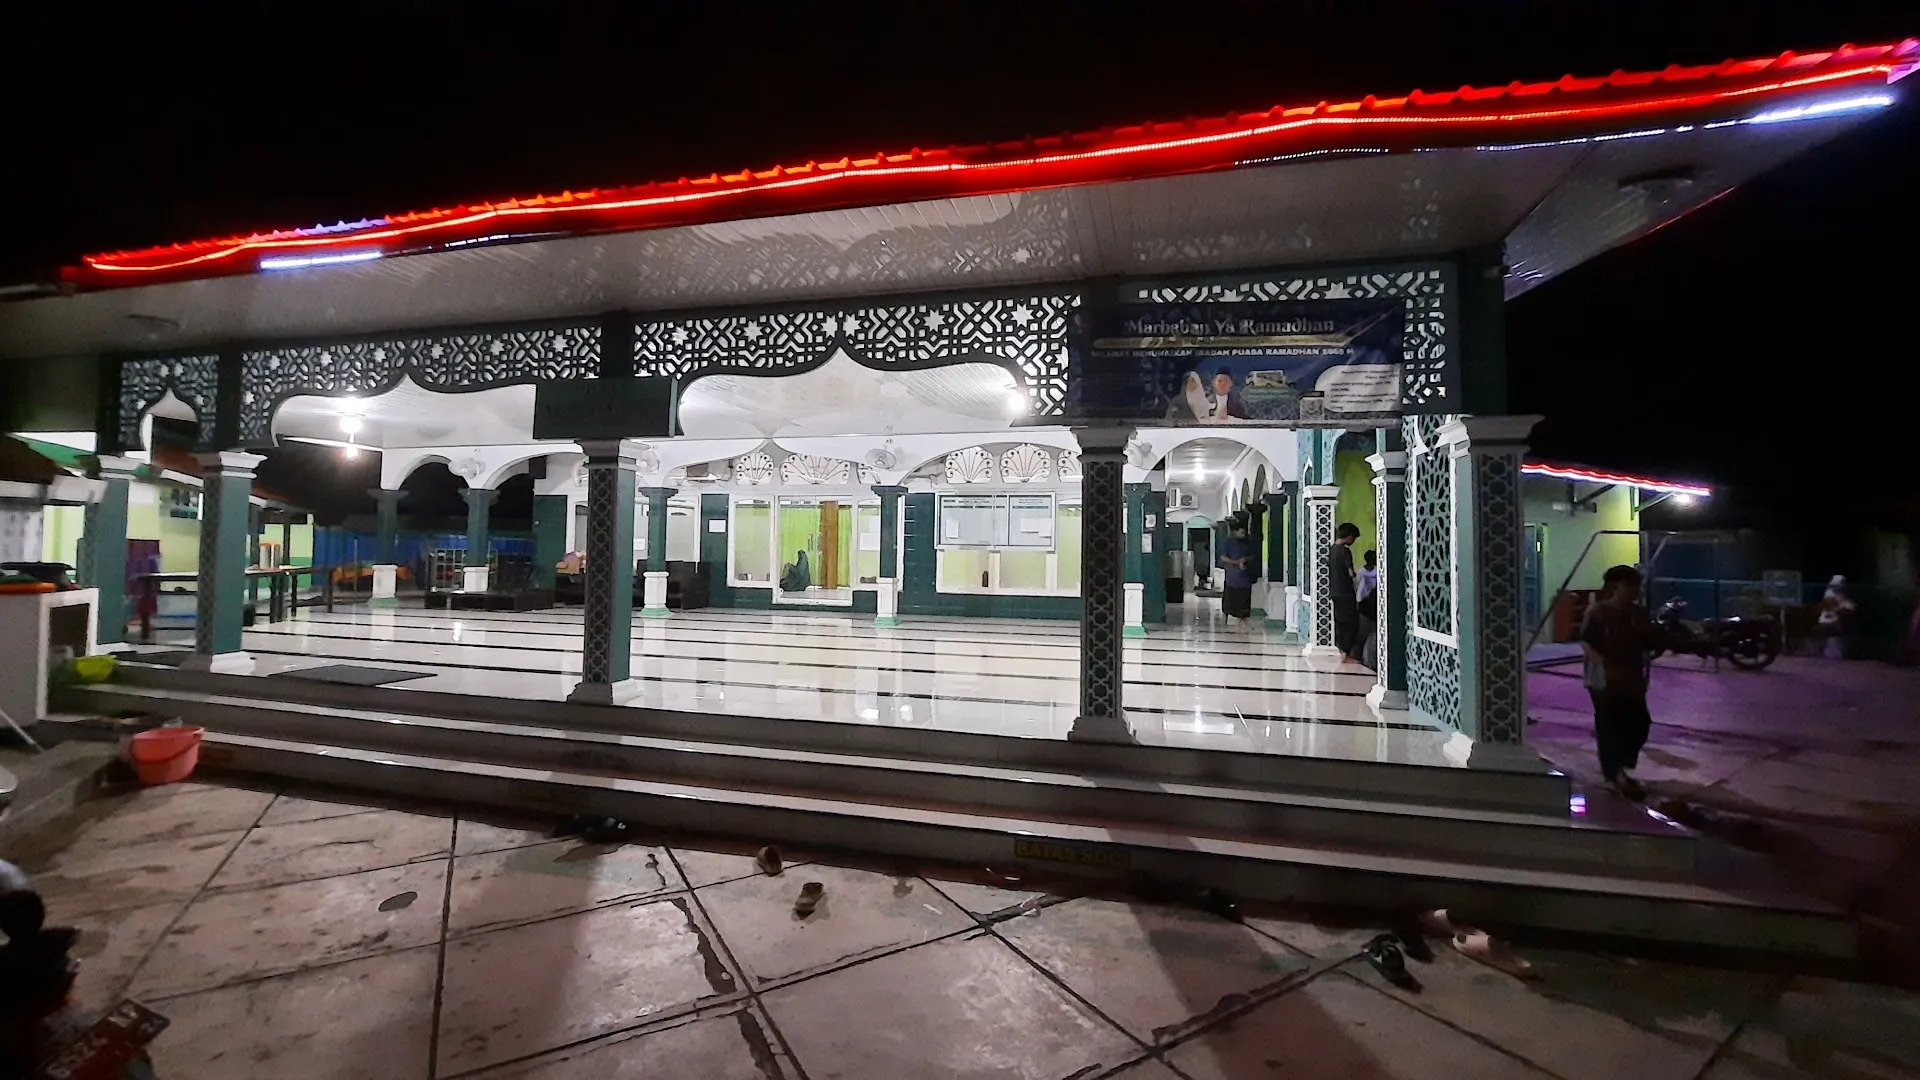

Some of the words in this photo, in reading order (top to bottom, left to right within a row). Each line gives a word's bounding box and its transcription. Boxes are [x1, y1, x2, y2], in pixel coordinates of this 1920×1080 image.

[1214, 319, 1236, 334] Ya
[1239, 317, 1335, 336] Ramadhan
[1231, 347, 1264, 357] PUASA
[1265, 347, 1321, 356] RAMADHAN
